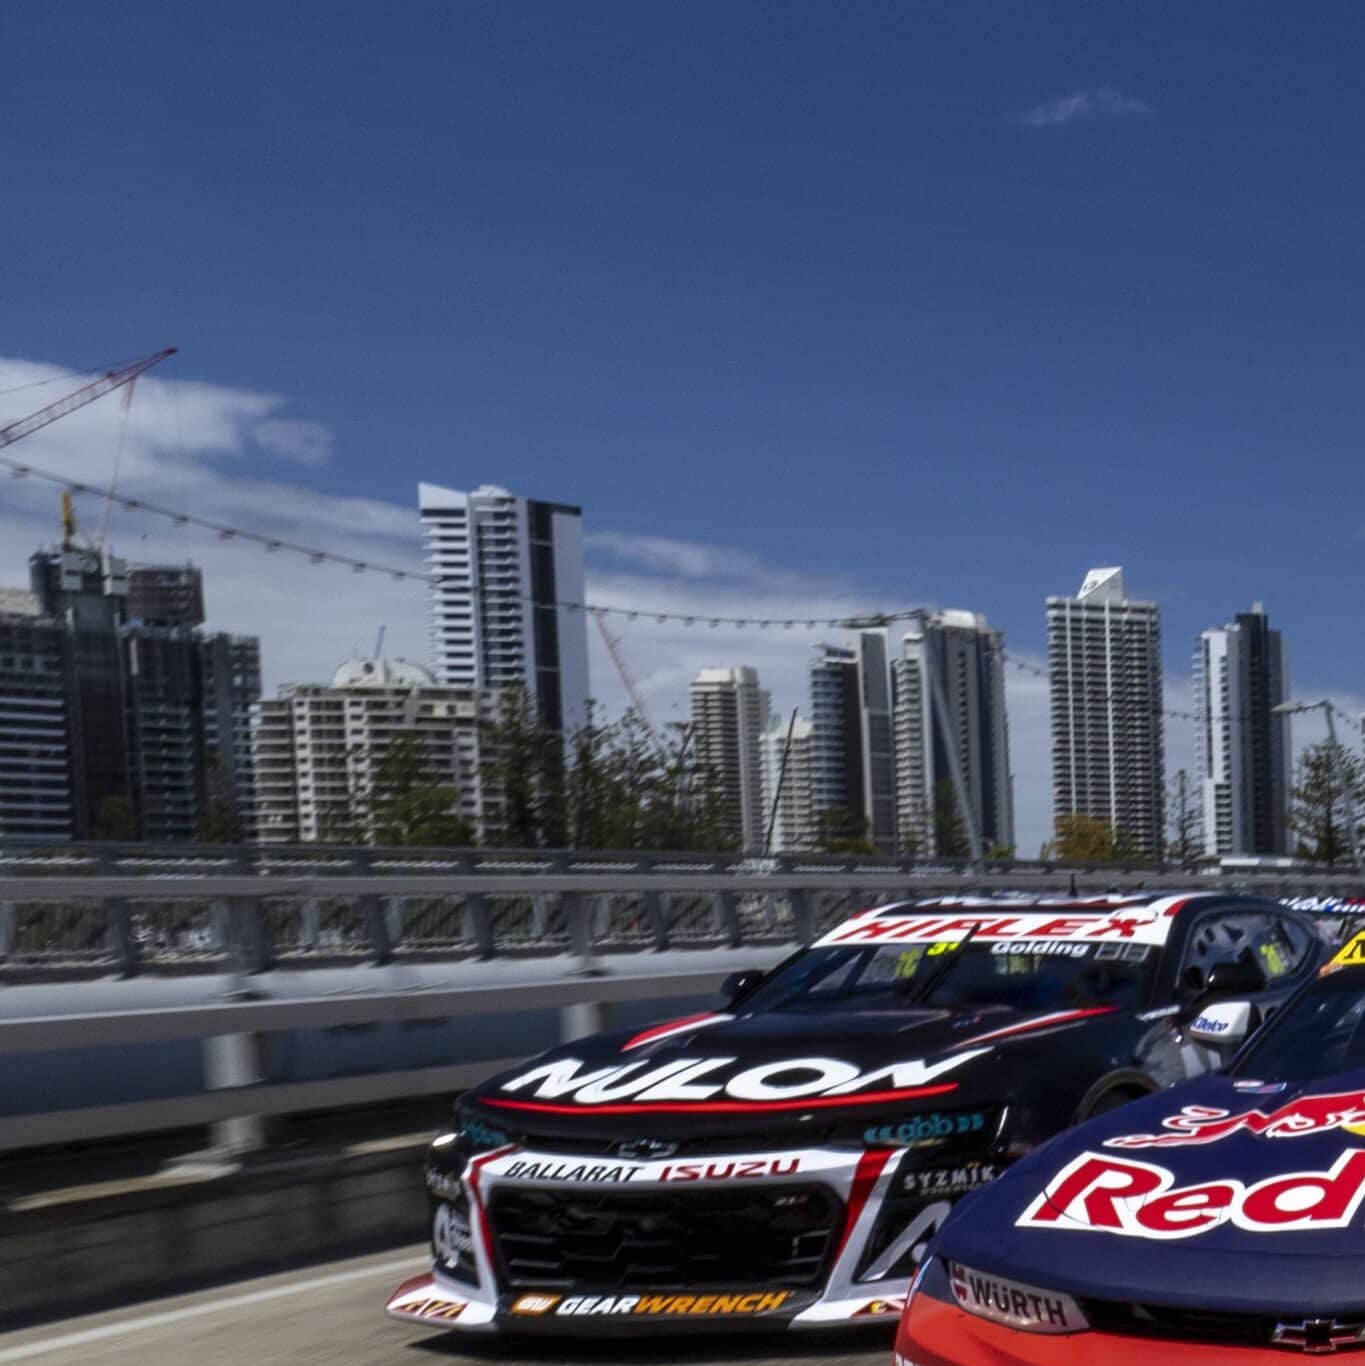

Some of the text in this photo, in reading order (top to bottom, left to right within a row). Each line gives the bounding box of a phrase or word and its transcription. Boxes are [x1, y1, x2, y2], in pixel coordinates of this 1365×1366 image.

[991, 941, 1092, 959] Golding
[501, 1046, 995, 1103] NULON
[503, 1158, 801, 1183] BALLARAT ISUZU
[556, 1291, 792, 1316] GEARWRENCH
